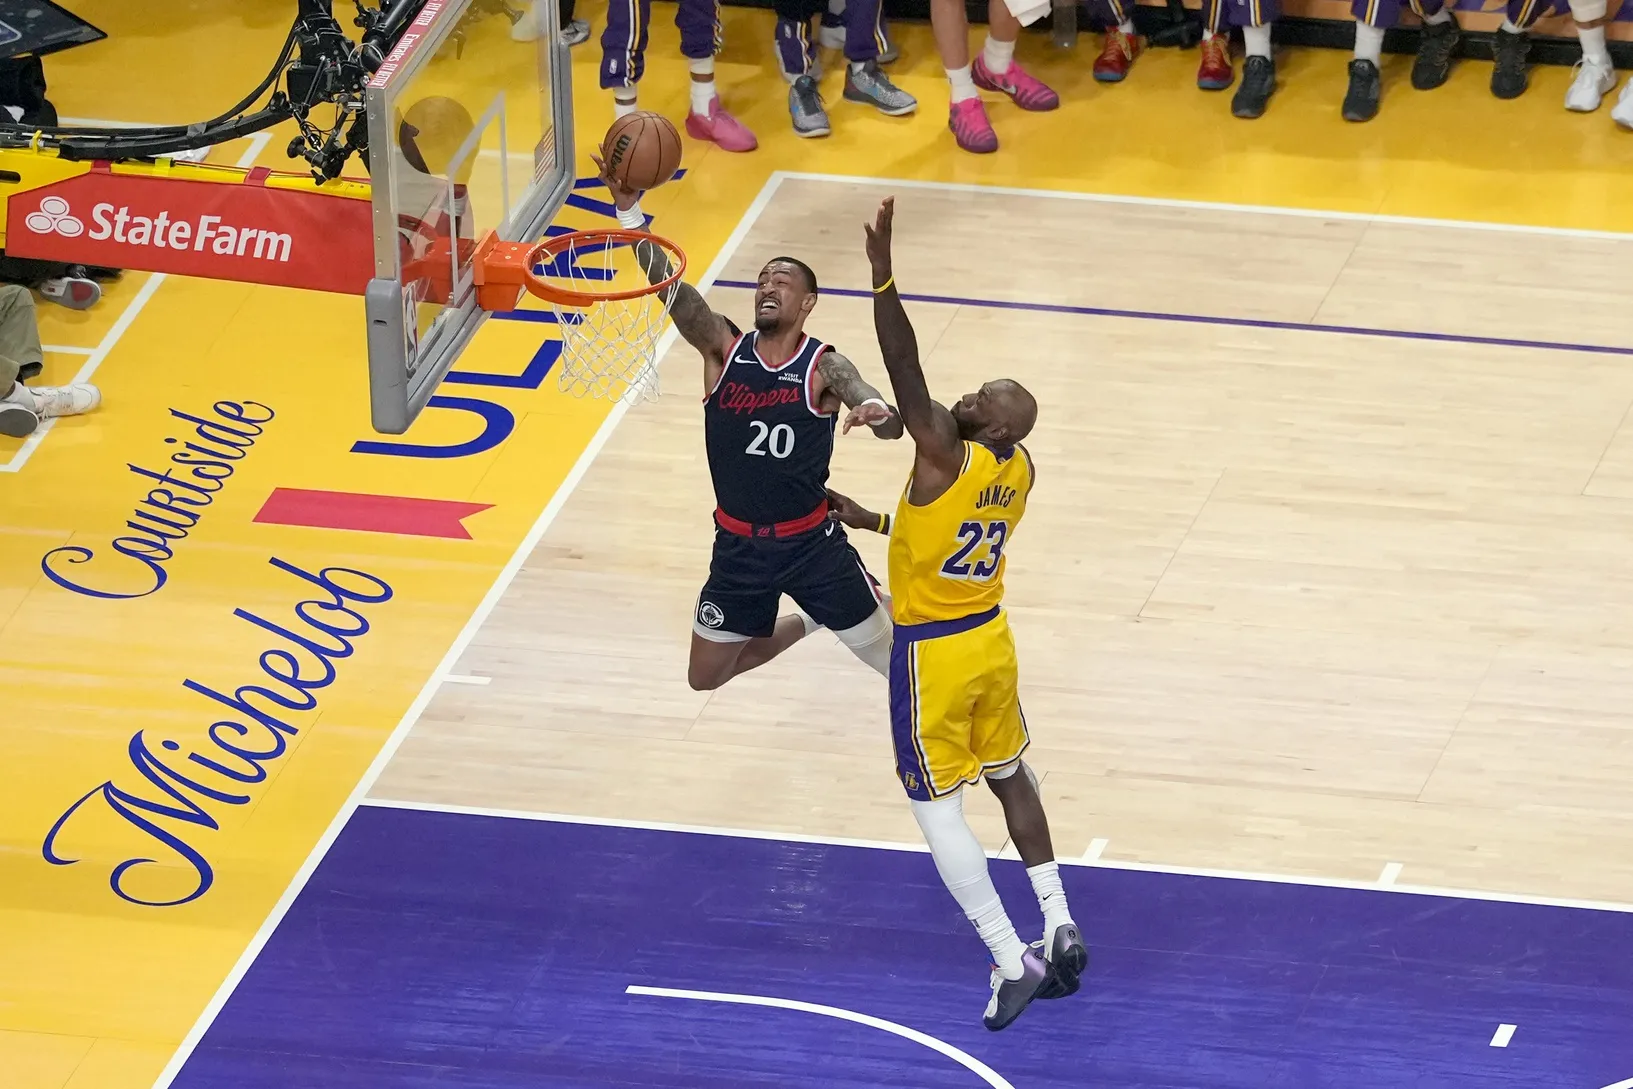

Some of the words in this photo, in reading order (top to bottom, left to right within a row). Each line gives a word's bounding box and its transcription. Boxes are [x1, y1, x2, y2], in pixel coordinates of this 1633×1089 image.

[388, 33, 421, 62] Emirates
[777, 375, 803, 384] RWANDA
[719, 382, 801, 416] Clippers
[745, 420, 795, 459] 20
[41, 400, 275, 600] Courtside
[976, 484, 1017, 510] JAMES
[938, 519, 1009, 582] 23
[42, 555, 394, 907] Michelob
